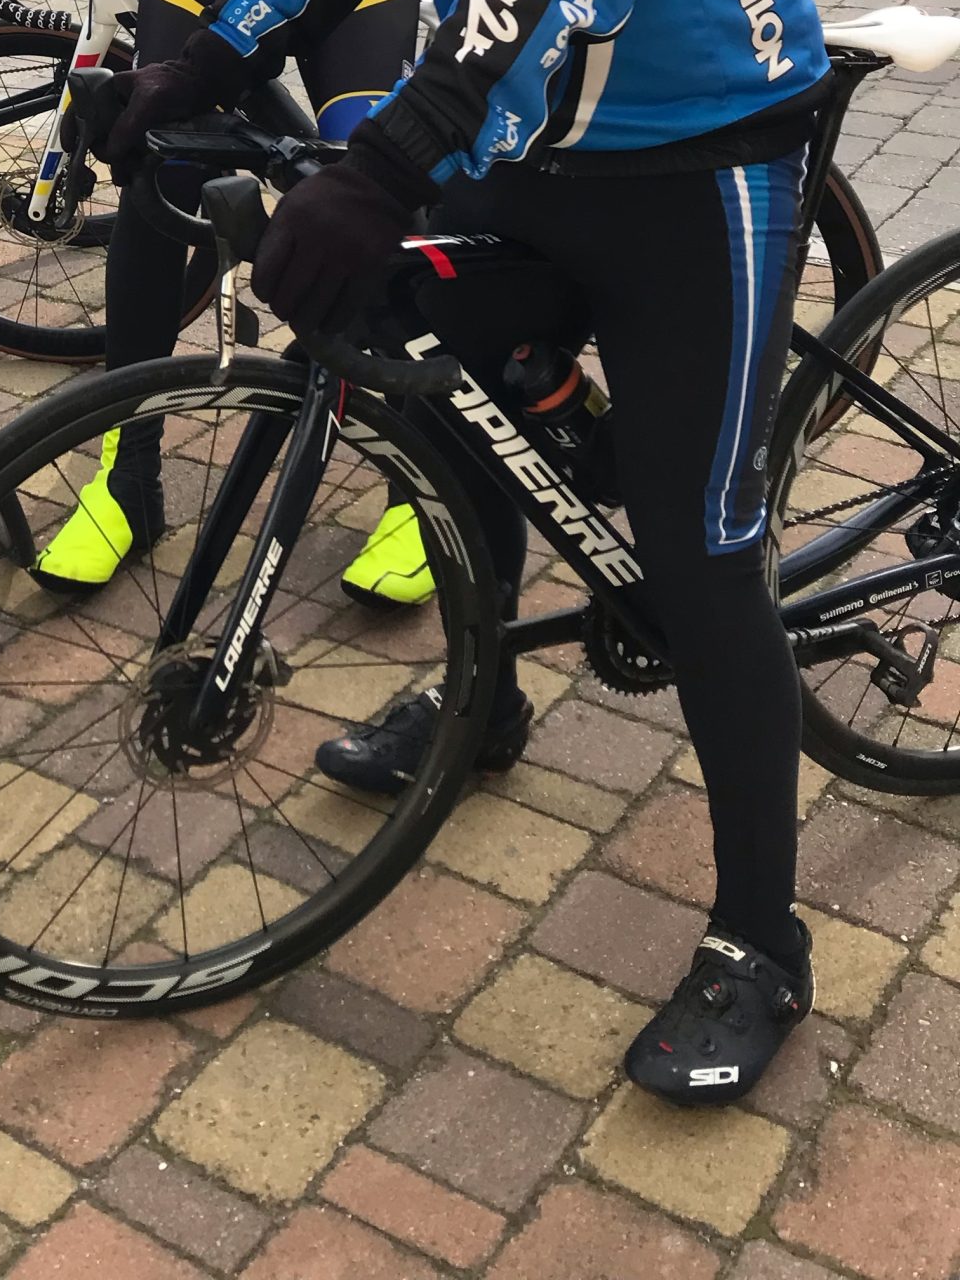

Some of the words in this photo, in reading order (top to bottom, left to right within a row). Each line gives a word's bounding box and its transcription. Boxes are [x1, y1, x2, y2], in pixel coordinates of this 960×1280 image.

[869, 582, 913, 605] Continental
[215, 536, 284, 693] LAPIERRE
[819, 599, 865, 623] SHIMANO
